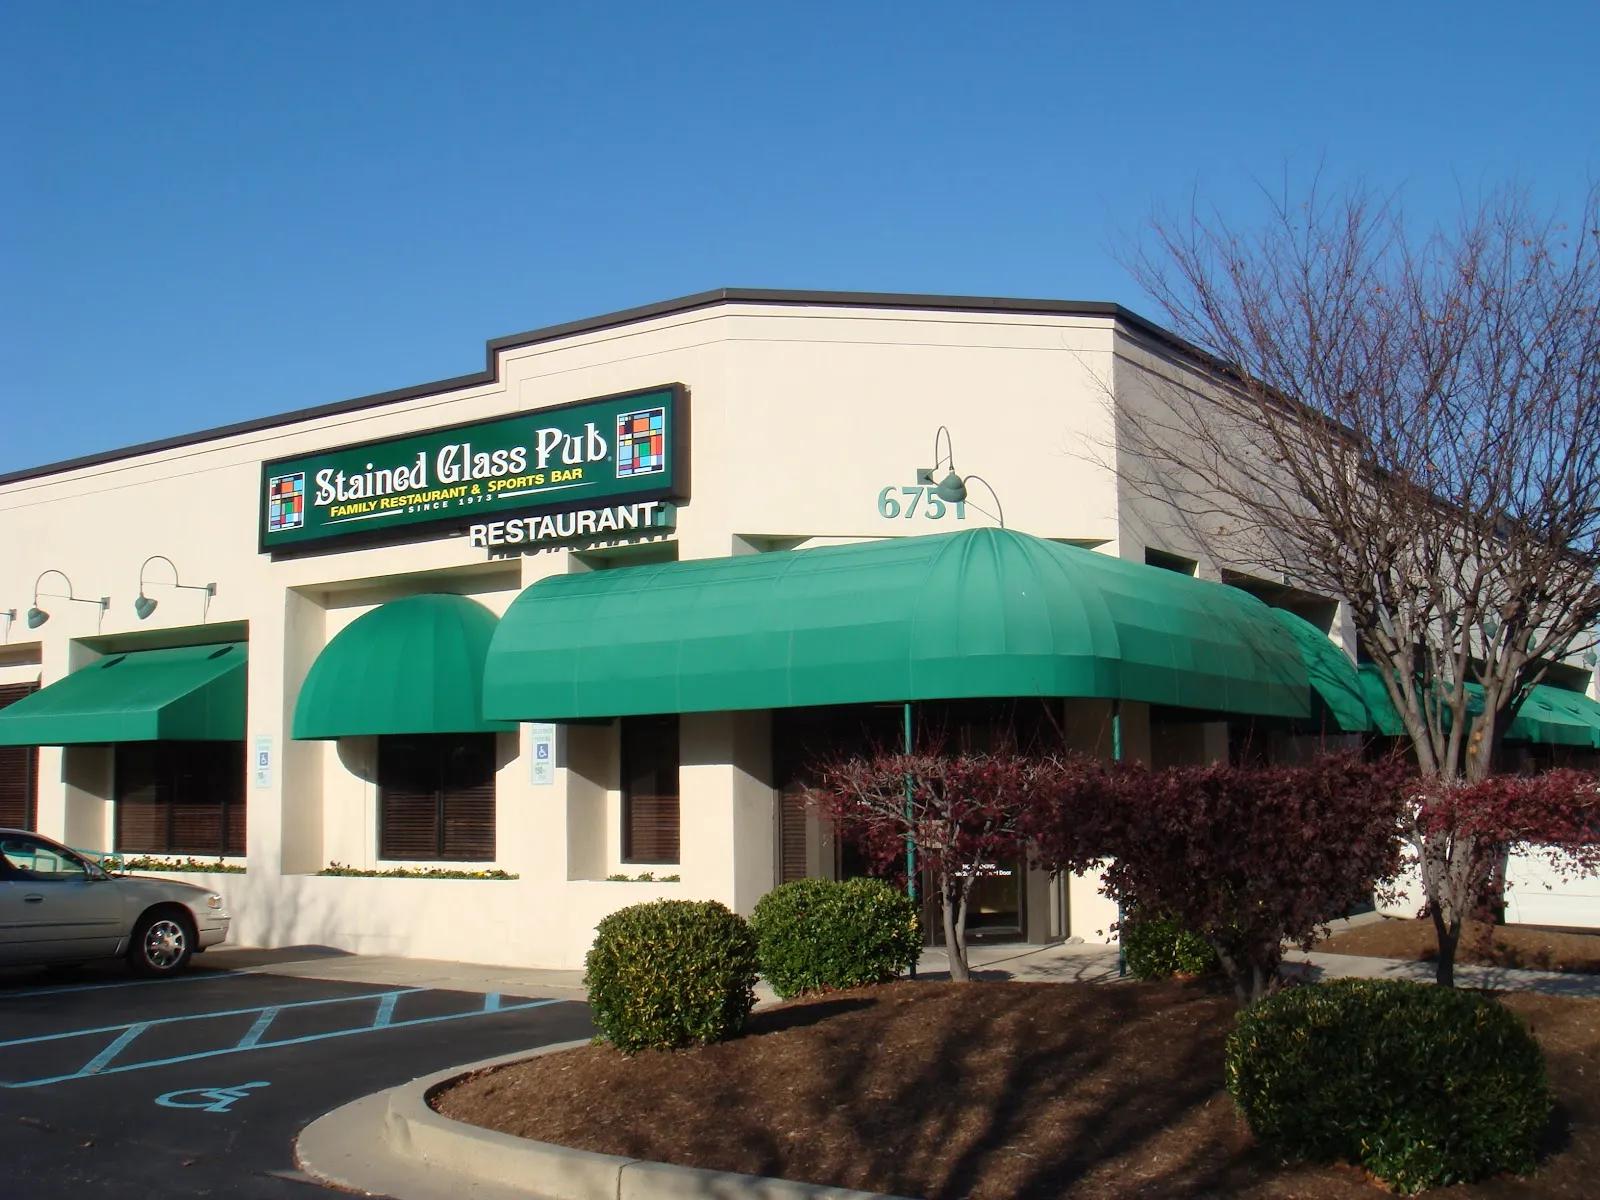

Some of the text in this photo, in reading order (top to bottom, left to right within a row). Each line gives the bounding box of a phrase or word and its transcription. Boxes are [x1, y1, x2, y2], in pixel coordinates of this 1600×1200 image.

[314, 422, 608, 506] Stained Glass Pub
[330, 468, 583, 518] FAMILY RESTAURANT & SPORTS BAR
[408, 494, 492, 513] SINCE 1973
[469, 501, 659, 547] RESTAURANT
